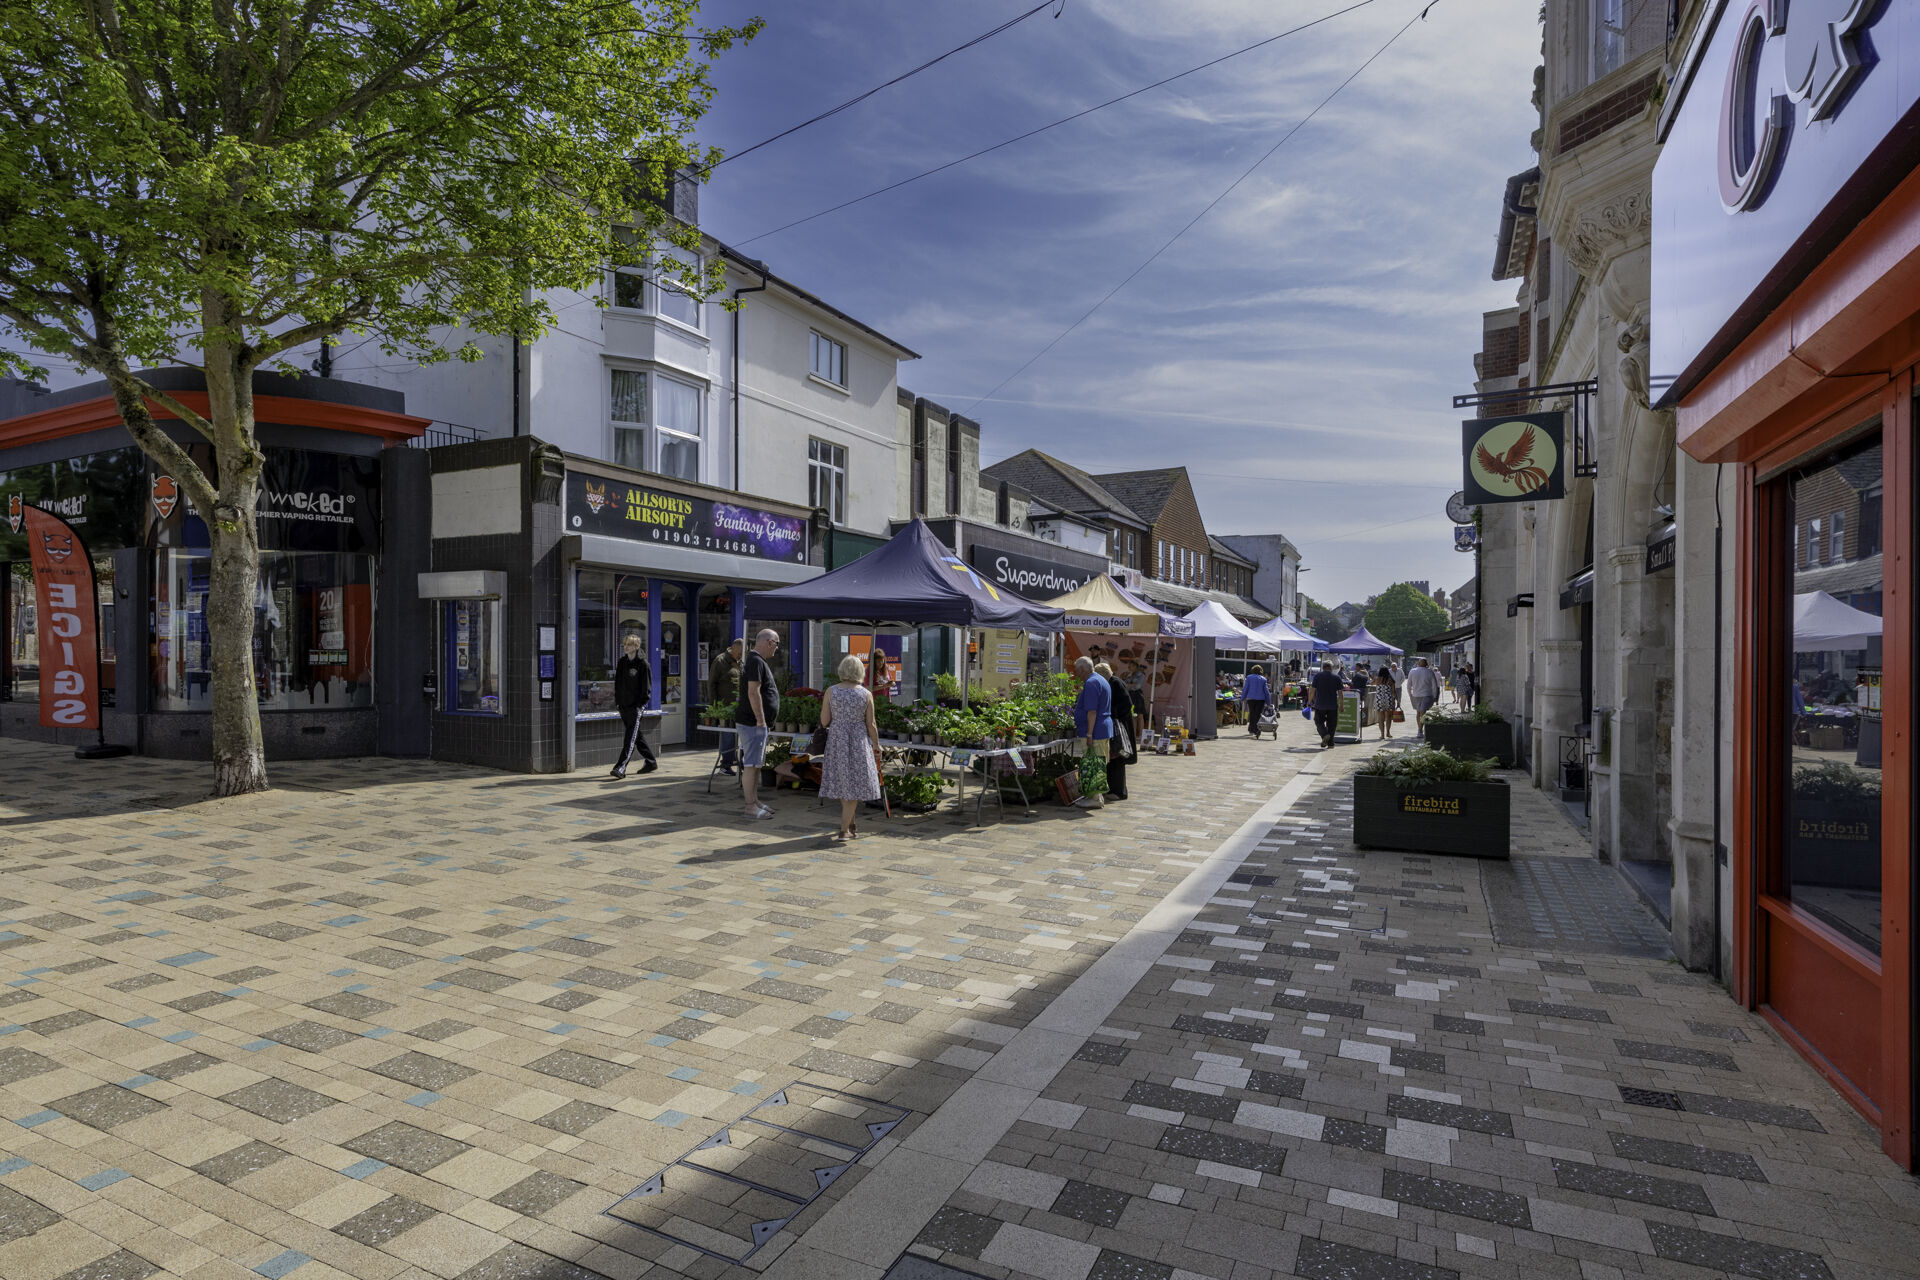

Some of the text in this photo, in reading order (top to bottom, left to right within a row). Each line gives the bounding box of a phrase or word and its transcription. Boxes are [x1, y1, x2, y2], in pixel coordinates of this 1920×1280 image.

[625, 488, 693, 515] ALLSORTS
[187, 508, 355, 524] TH EMIER VAPING RETAILER
[625, 504, 686, 529] AIRSOFT
[715, 510, 801, 542] Fantasy Games
[652, 529, 756, 555] 01903 714688
[1650, 541, 1676, 569] Small Pl
[319, 590, 334, 611] 20
[1064, 618, 1080, 626] ake
[1093, 618, 1109, 628] dog
[1110, 618, 1130, 627] food
[1404, 795, 1459, 809] firebird
[1404, 806, 1441, 814] RESTAURANT
